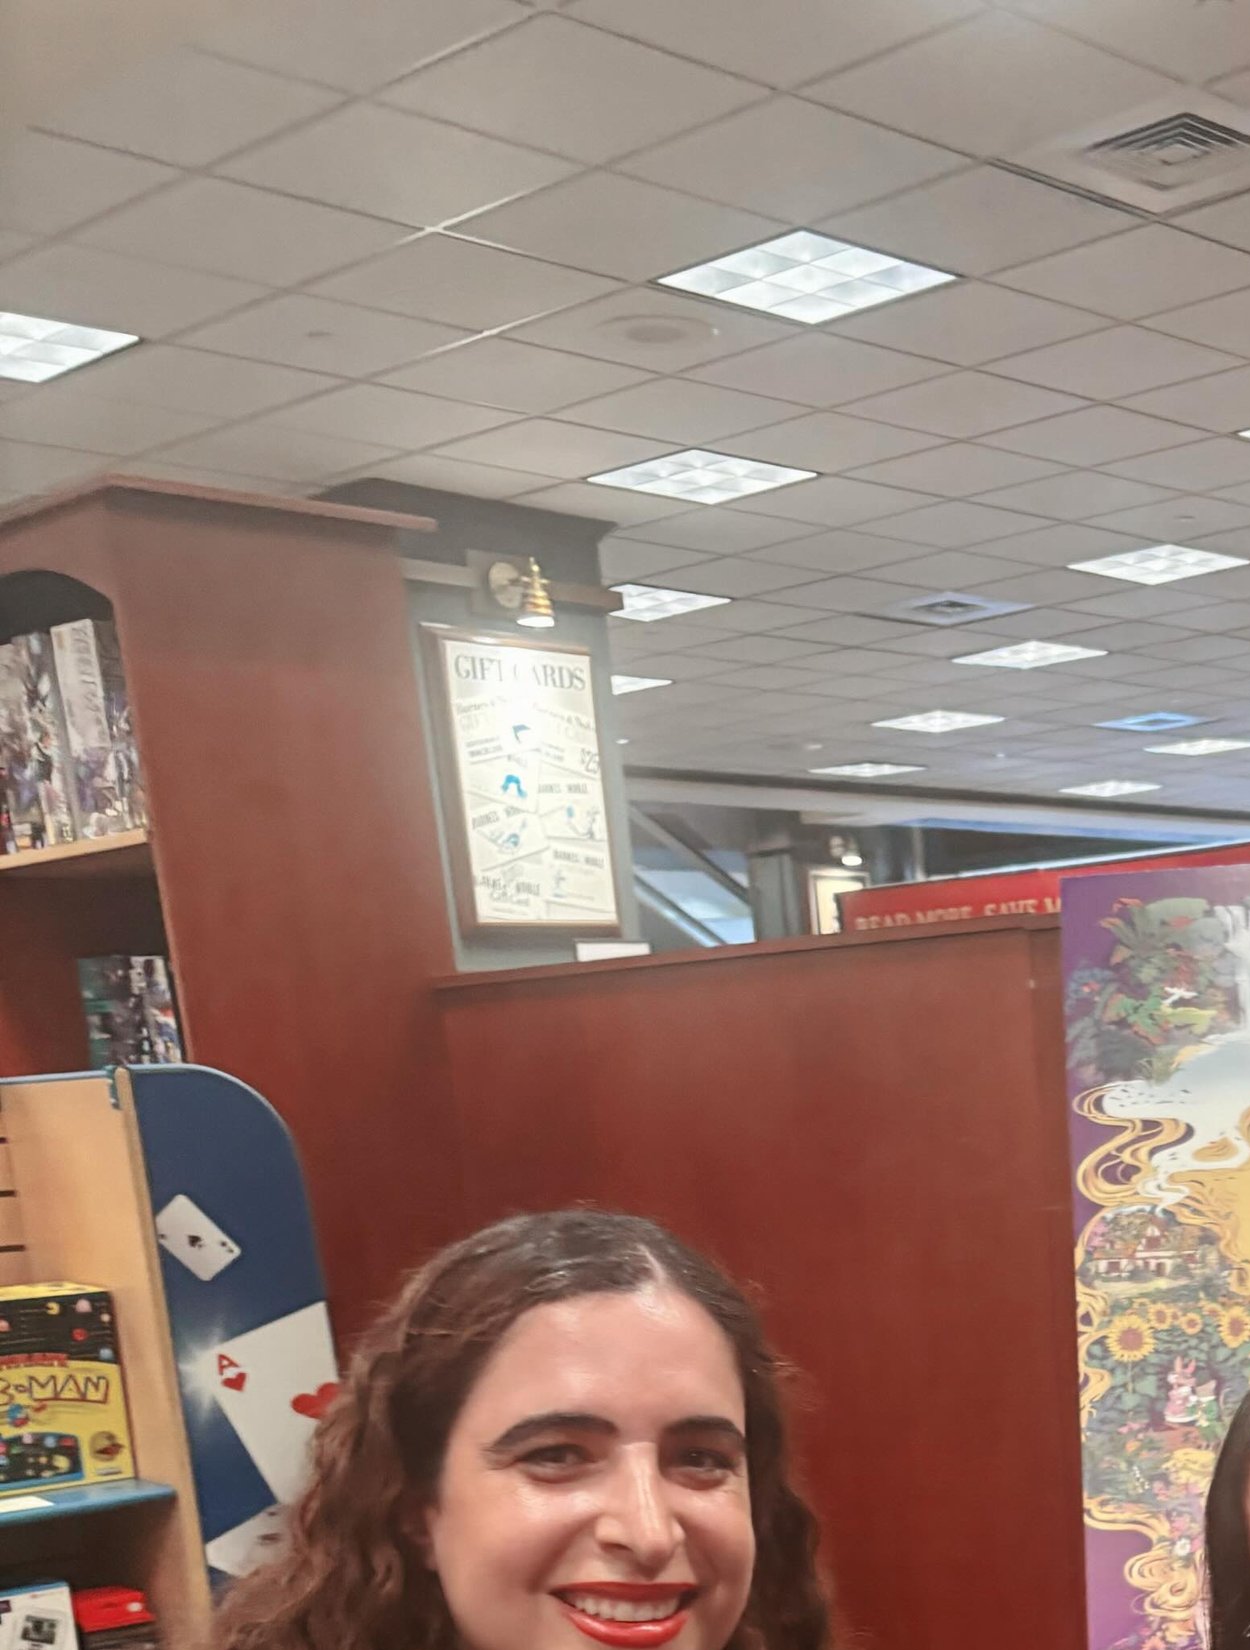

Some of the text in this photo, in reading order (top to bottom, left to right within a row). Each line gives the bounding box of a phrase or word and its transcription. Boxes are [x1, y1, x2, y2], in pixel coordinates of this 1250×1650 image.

[454, 654, 503, 682] GIFT
[854, 913, 911, 931] READ
[915, 906, 973, 924] MORE
